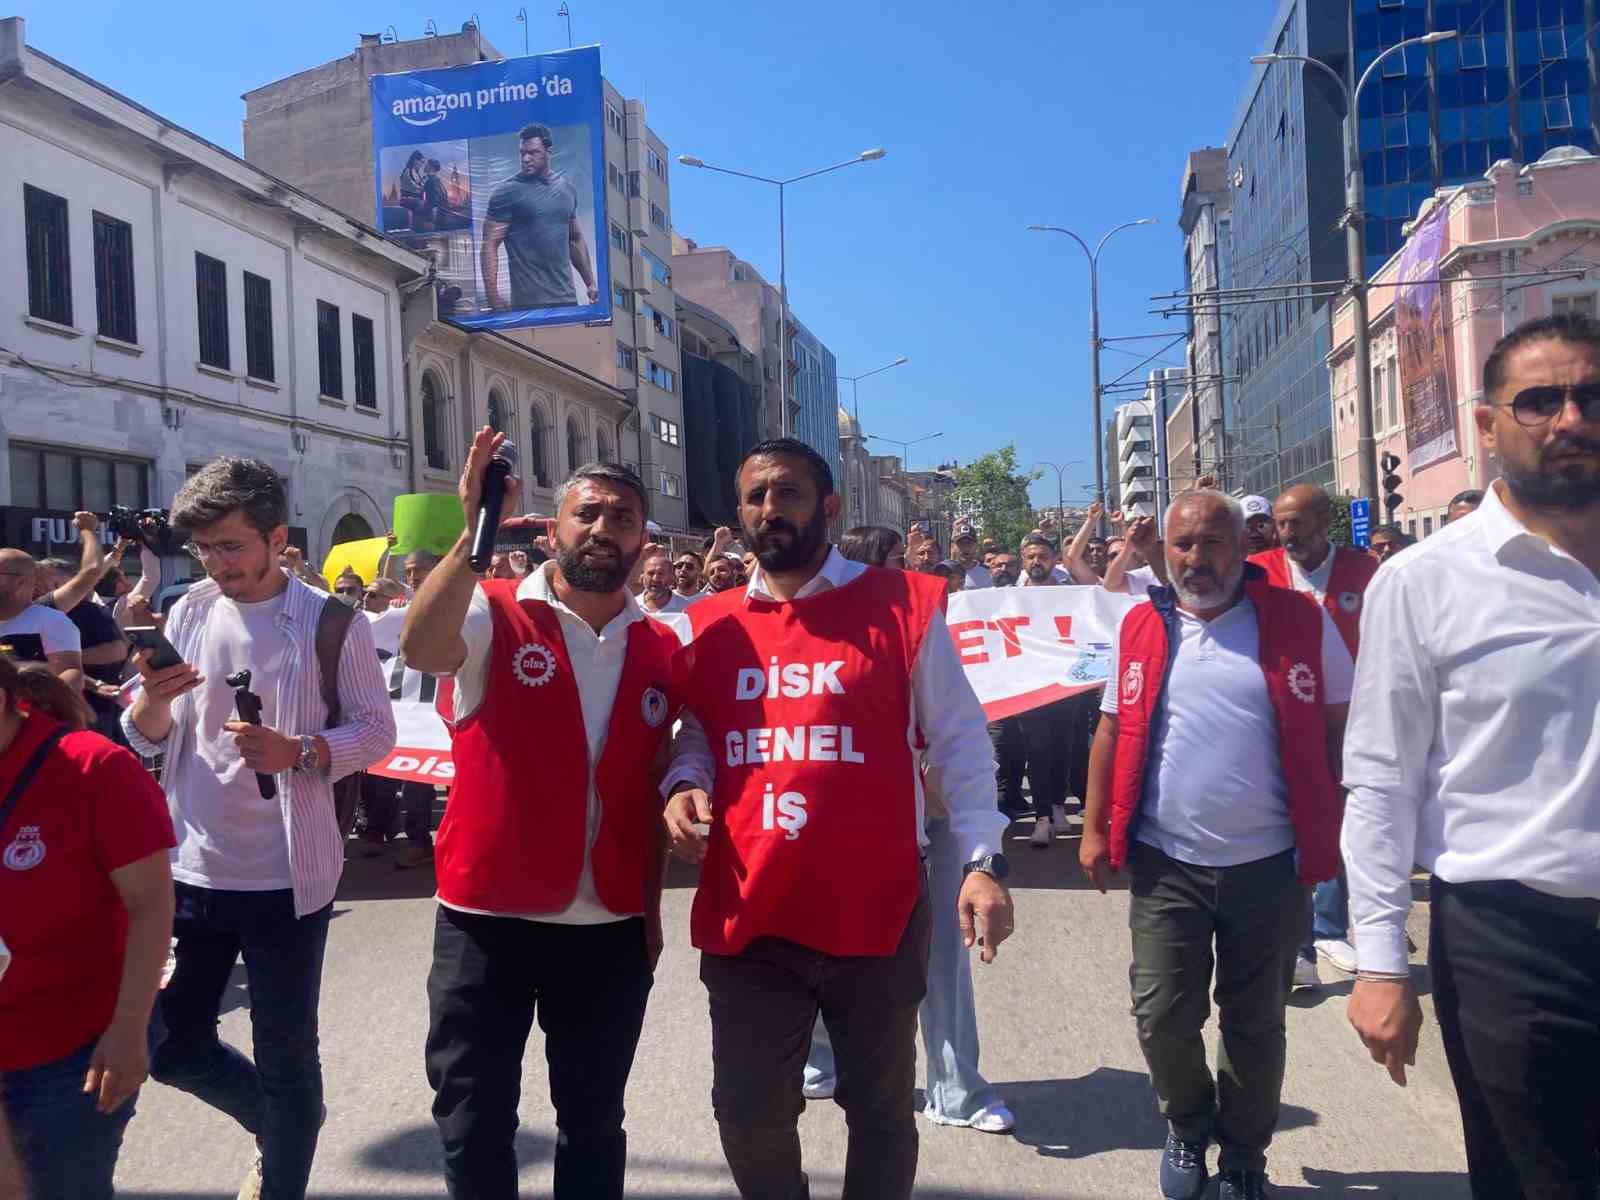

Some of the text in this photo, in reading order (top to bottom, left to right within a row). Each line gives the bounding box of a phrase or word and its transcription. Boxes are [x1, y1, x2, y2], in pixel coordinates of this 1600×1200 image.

[392, 91, 471, 116] amazon
[476, 81, 538, 110] prime
[735, 655, 846, 701] DİSK
[725, 724, 866, 768] GENEL
[761, 782, 809, 841] İŞ
